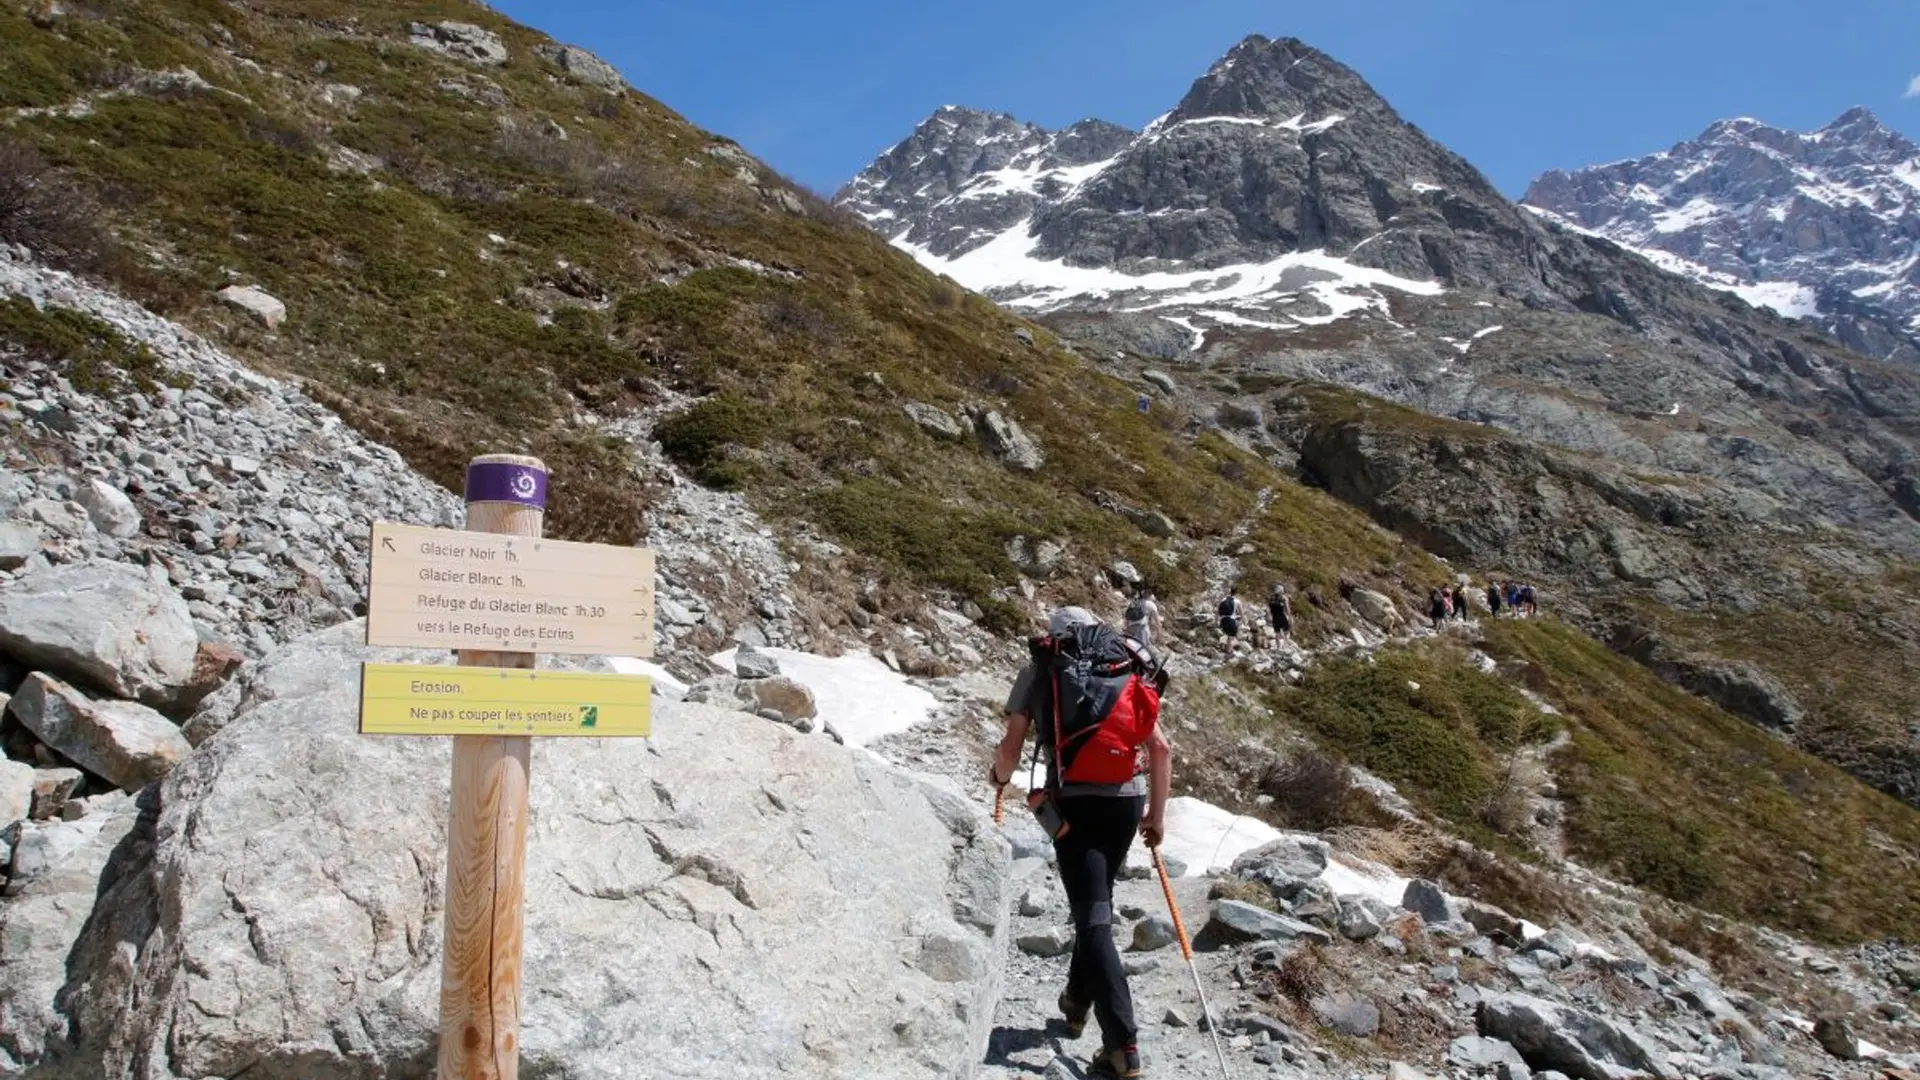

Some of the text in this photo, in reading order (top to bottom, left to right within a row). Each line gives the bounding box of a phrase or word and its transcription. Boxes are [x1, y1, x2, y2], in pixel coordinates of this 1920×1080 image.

[420, 541, 465, 557] Glacier
[469, 546, 497, 561] Noir
[419, 567, 526, 588] Glacier Blanc 1h.
[417, 594, 466, 612] Refuge
[470, 597, 486, 611] du
[489, 599, 533, 613] Glacier
[536, 601, 568, 616] Blanc
[417, 620, 575, 640] vers le Refuge des Ecrins
[410, 706, 574, 724] Ne pas couper les sentiers
